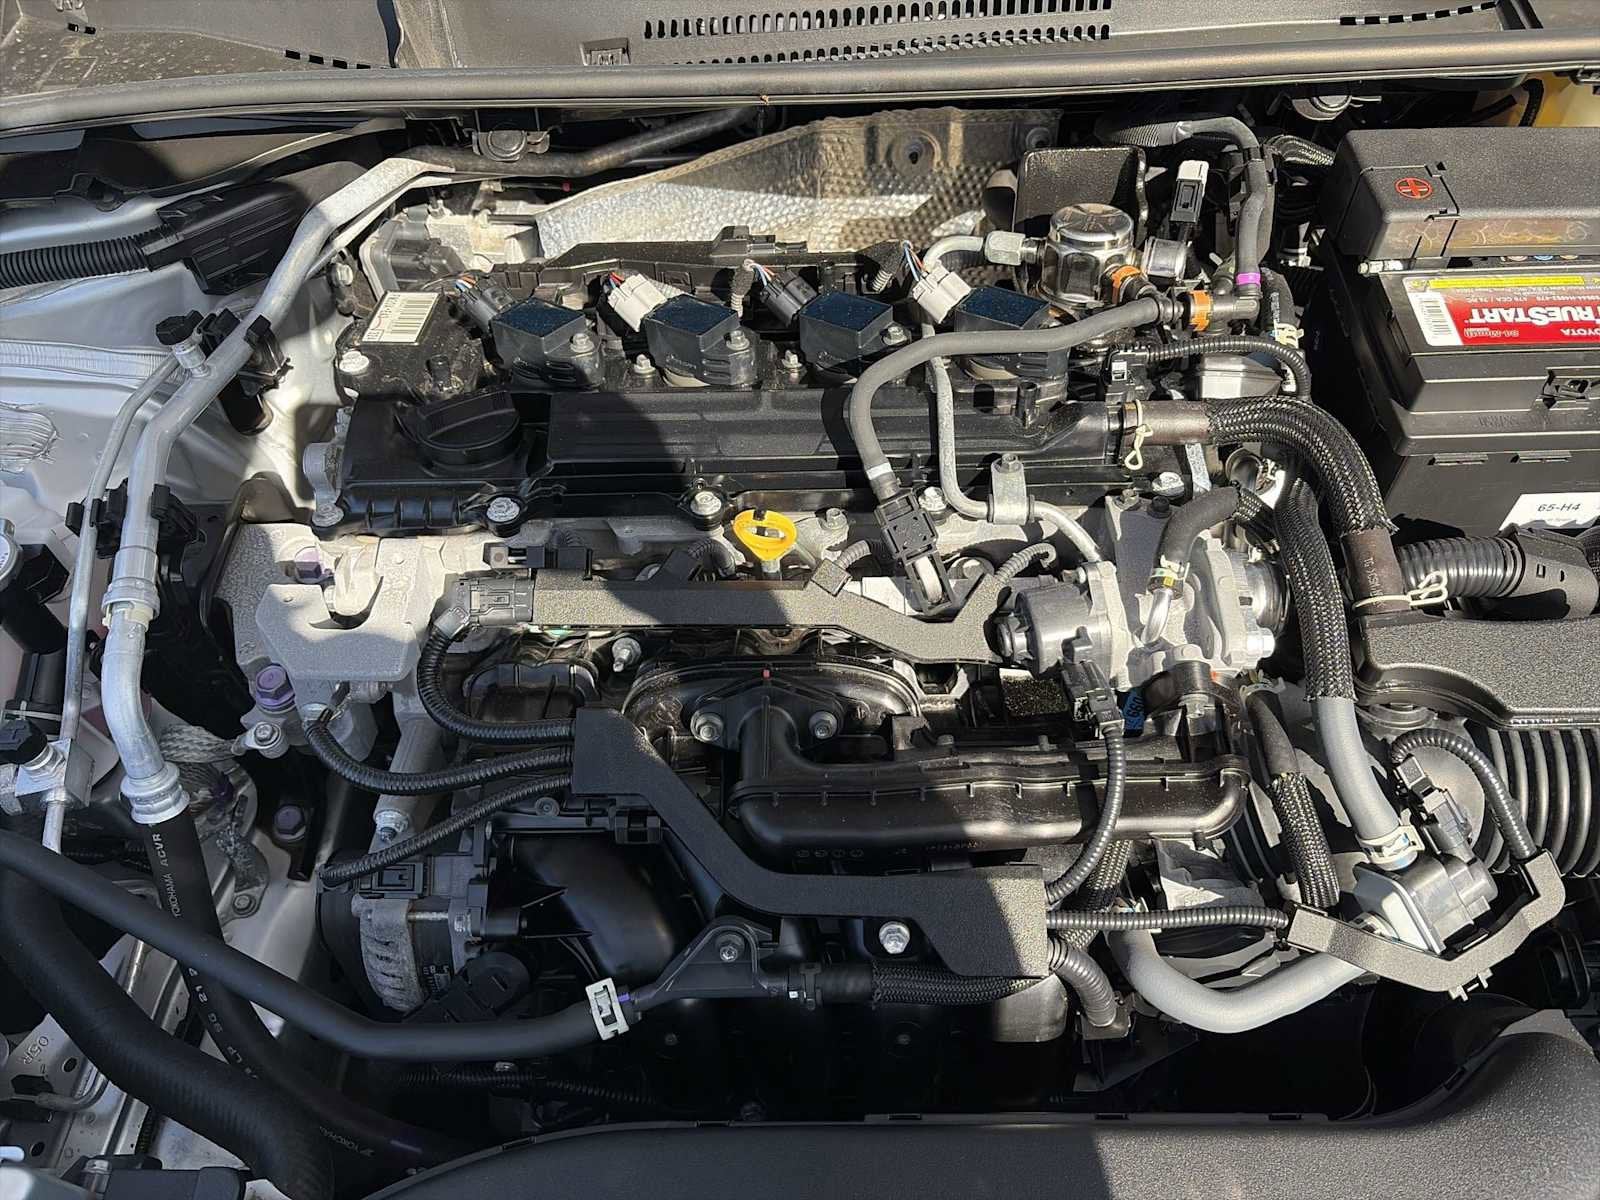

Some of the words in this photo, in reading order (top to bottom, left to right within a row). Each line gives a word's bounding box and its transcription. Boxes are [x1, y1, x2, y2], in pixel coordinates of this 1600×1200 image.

[1560, 328, 1600, 336] OYOTA
[1537, 503, 1581, 512] 65-H4
[152, 833, 168, 867] ACVR
[162, 873, 181, 917] YOKOHAMA
